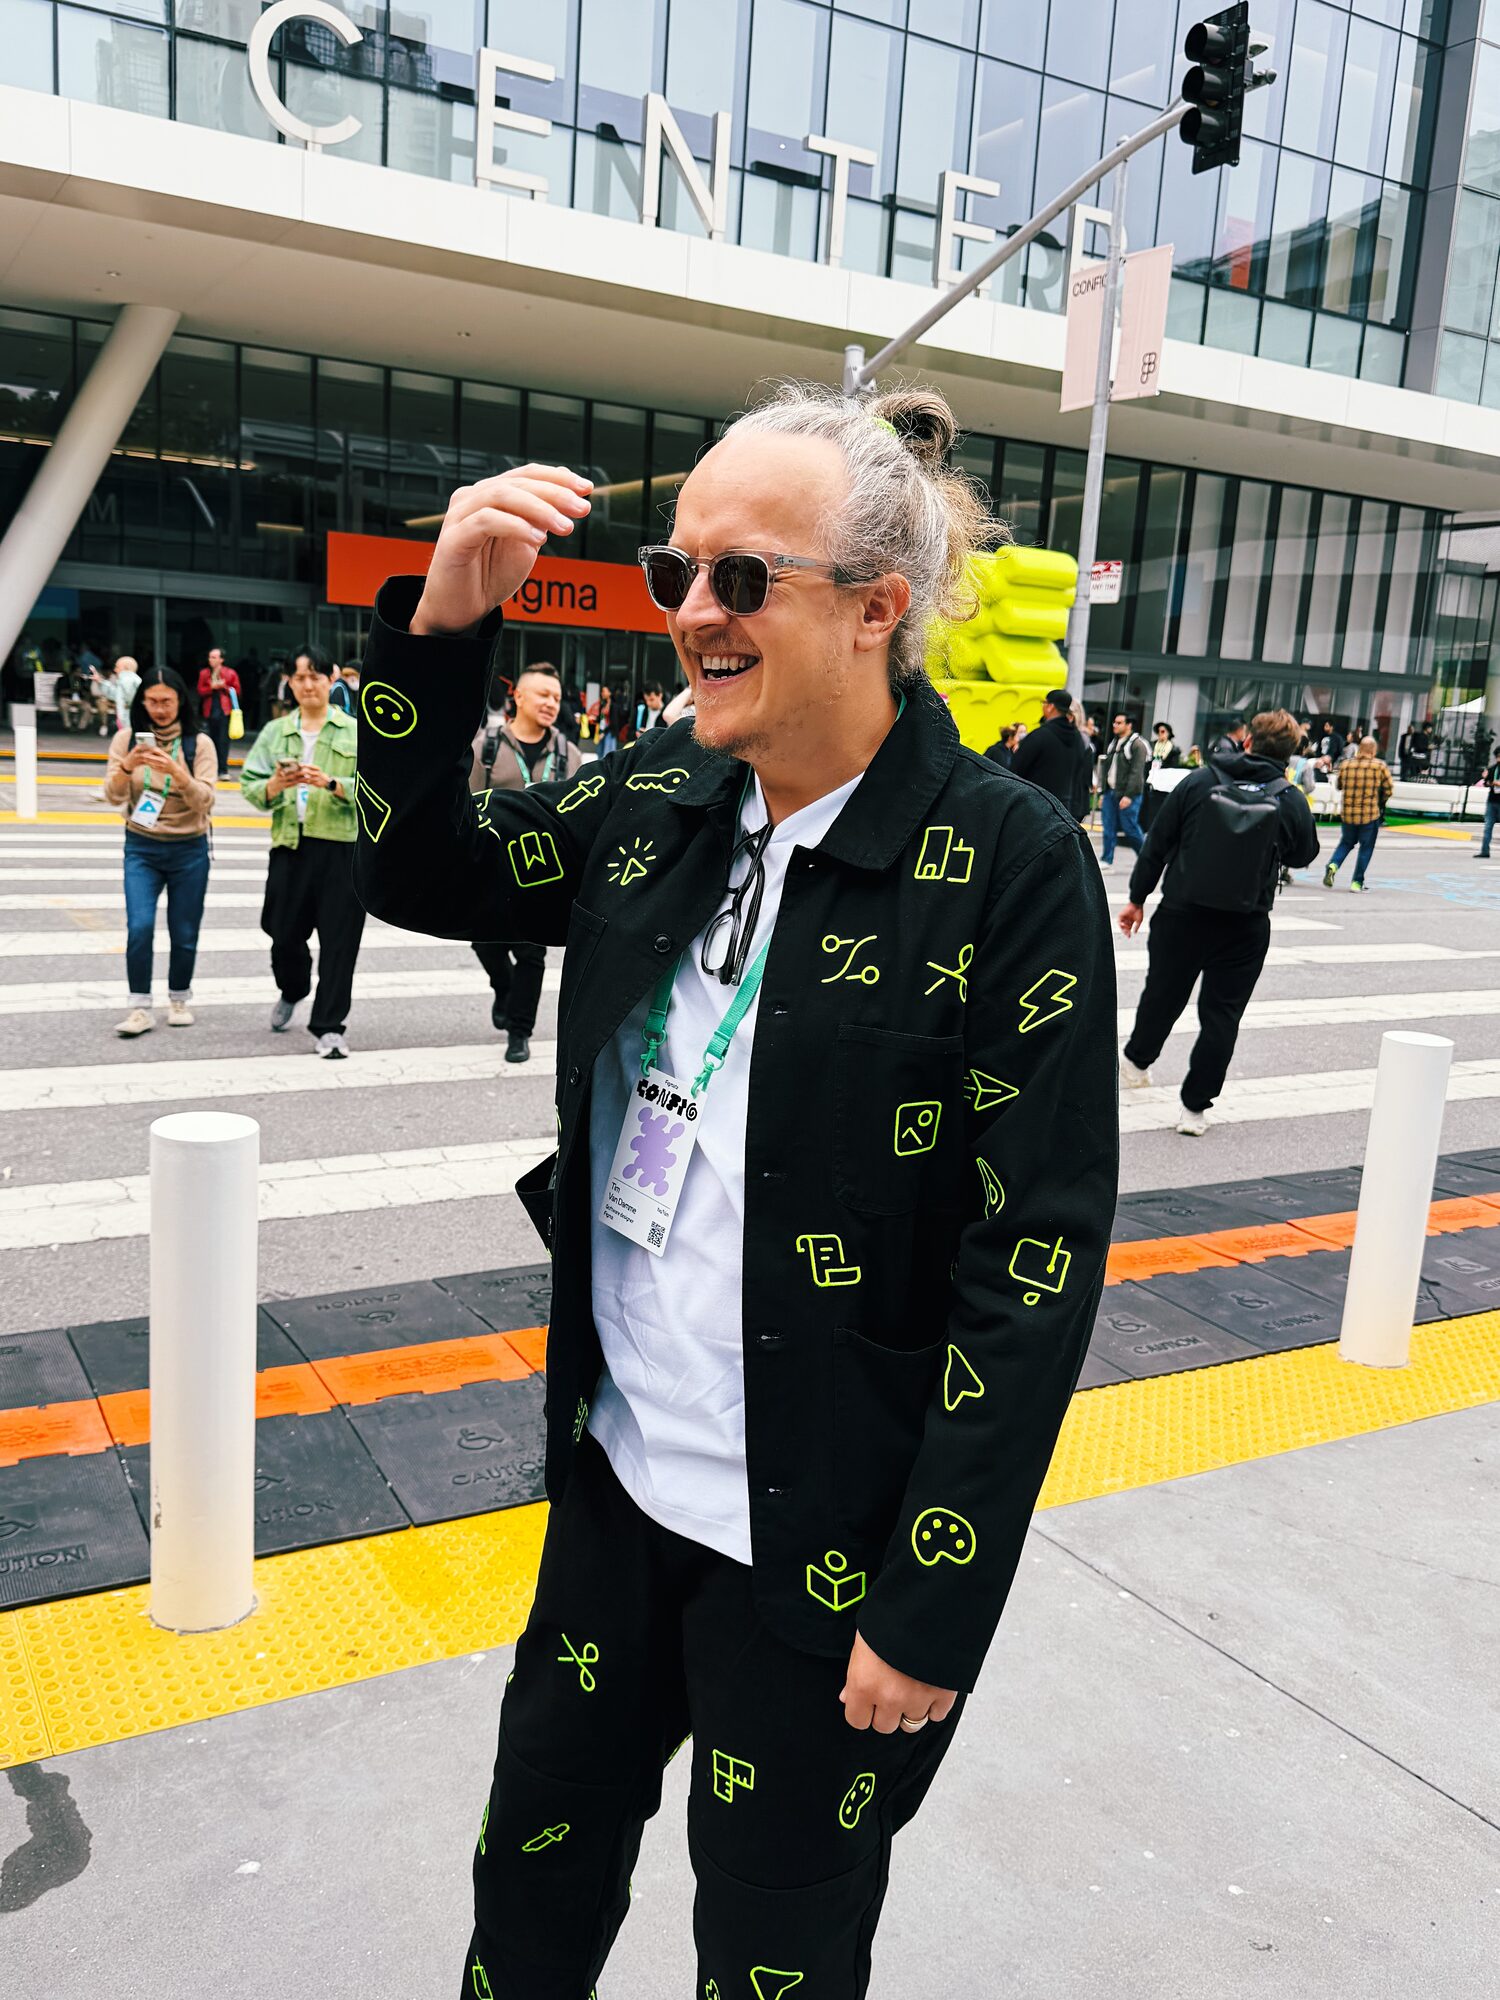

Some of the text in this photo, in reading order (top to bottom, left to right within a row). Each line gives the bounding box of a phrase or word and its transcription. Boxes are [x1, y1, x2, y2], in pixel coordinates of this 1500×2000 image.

[512, 578, 597, 614] gma
[637, 1079, 697, 1121] CONFIG
[608, 1192, 618, 1204] Van
[611, 1181, 621, 1194] Tim
[451, 1460, 546, 1487] CAUTIO
[255, 1499, 335, 1525] UTION
[0, 1544, 86, 1576] UTION
